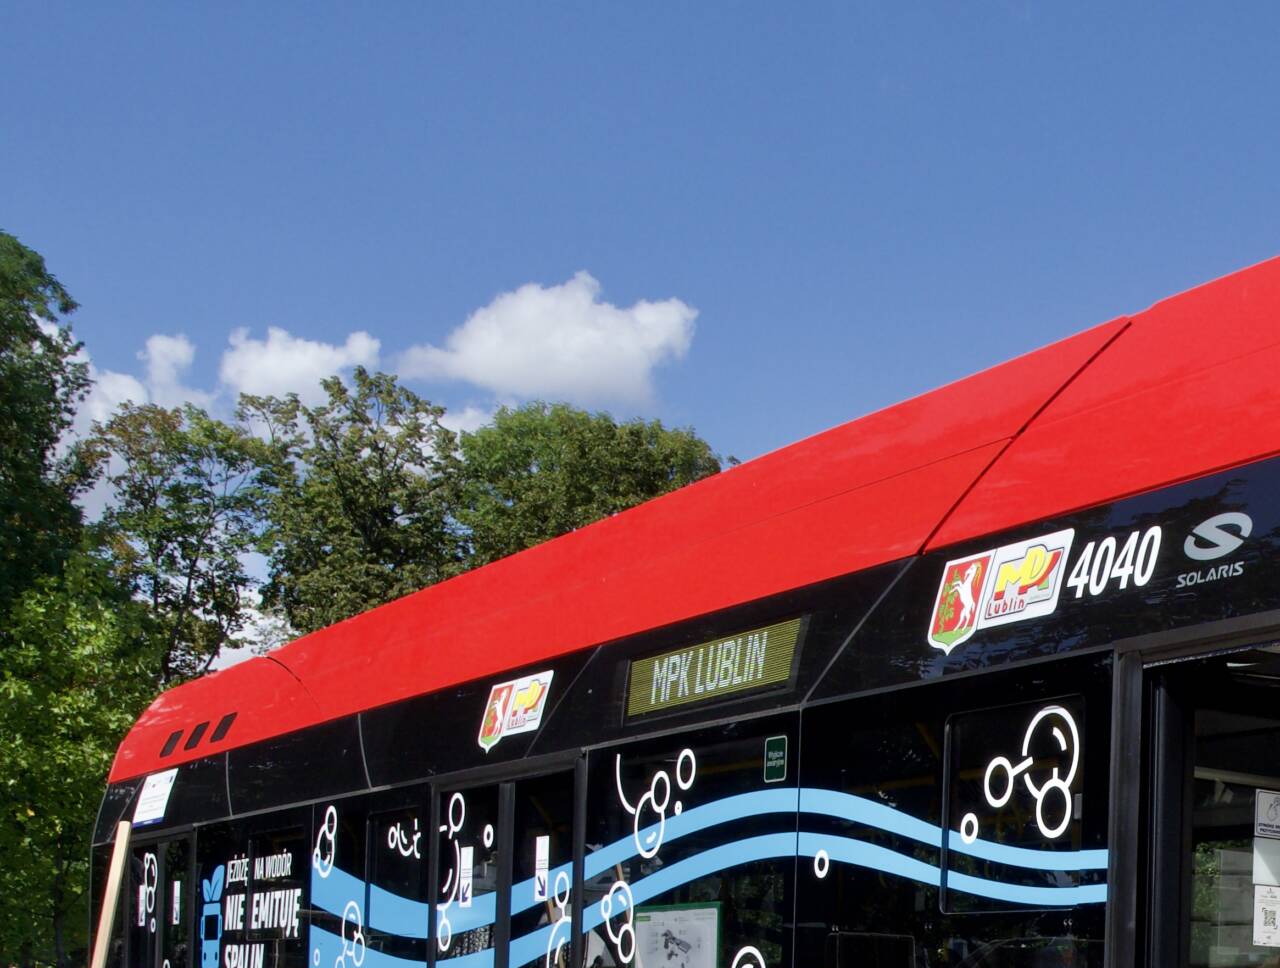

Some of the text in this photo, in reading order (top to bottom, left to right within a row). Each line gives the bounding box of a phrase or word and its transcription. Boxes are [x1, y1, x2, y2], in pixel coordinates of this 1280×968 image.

[1067, 526, 1162, 599] 4040
[1175, 561, 1245, 588] SOLARIS
[987, 598, 1025, 617] Lublin
[650, 632, 768, 704] MPK LUBLIN
[254, 857, 264, 880] NA
[265, 848, 292, 879] WODÓR
[224, 888, 302, 937] NIE EMITUJĘ
